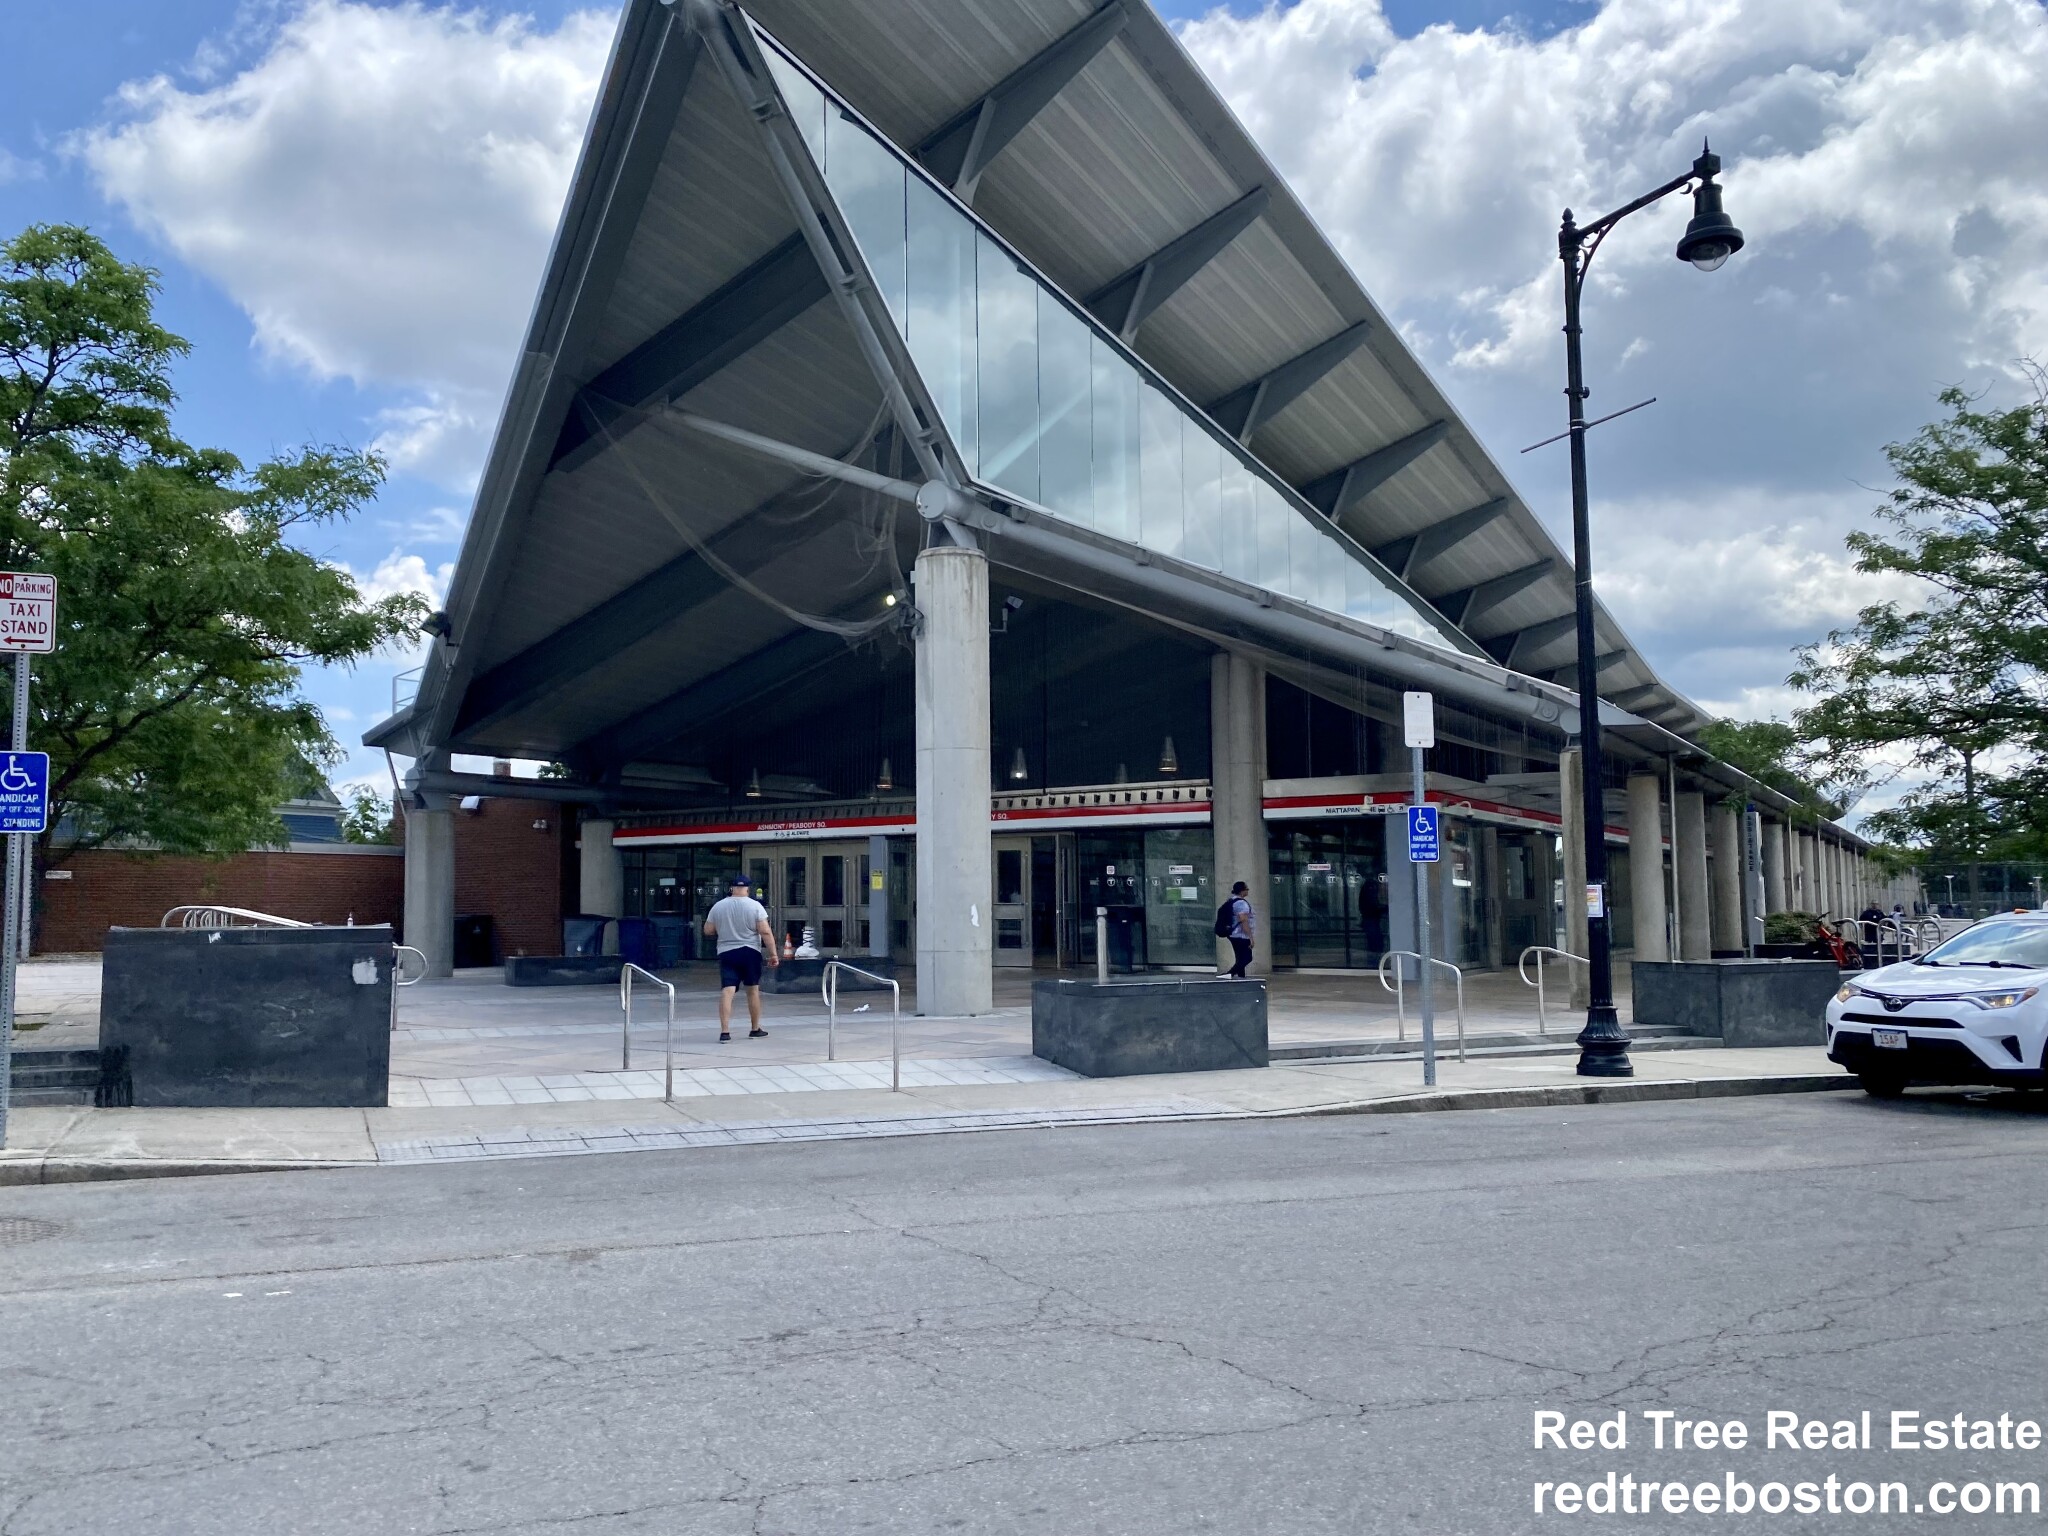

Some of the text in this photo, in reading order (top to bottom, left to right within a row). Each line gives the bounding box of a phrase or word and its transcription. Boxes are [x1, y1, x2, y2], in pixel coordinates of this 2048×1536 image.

[15, 582, 52, 594] PARKING
[9, 602, 41, 617] TAXI
[0, 620, 48, 635] STAND
[0, 793, 39, 803] ANDICAP
[24, 805, 42, 814] ZONE
[1325, 807, 1361, 815] MATTAPAN
[3, 818, 41, 828] STANDING
[757, 823, 785, 831] ASHMONT
[788, 821, 816, 830] PEABODY
